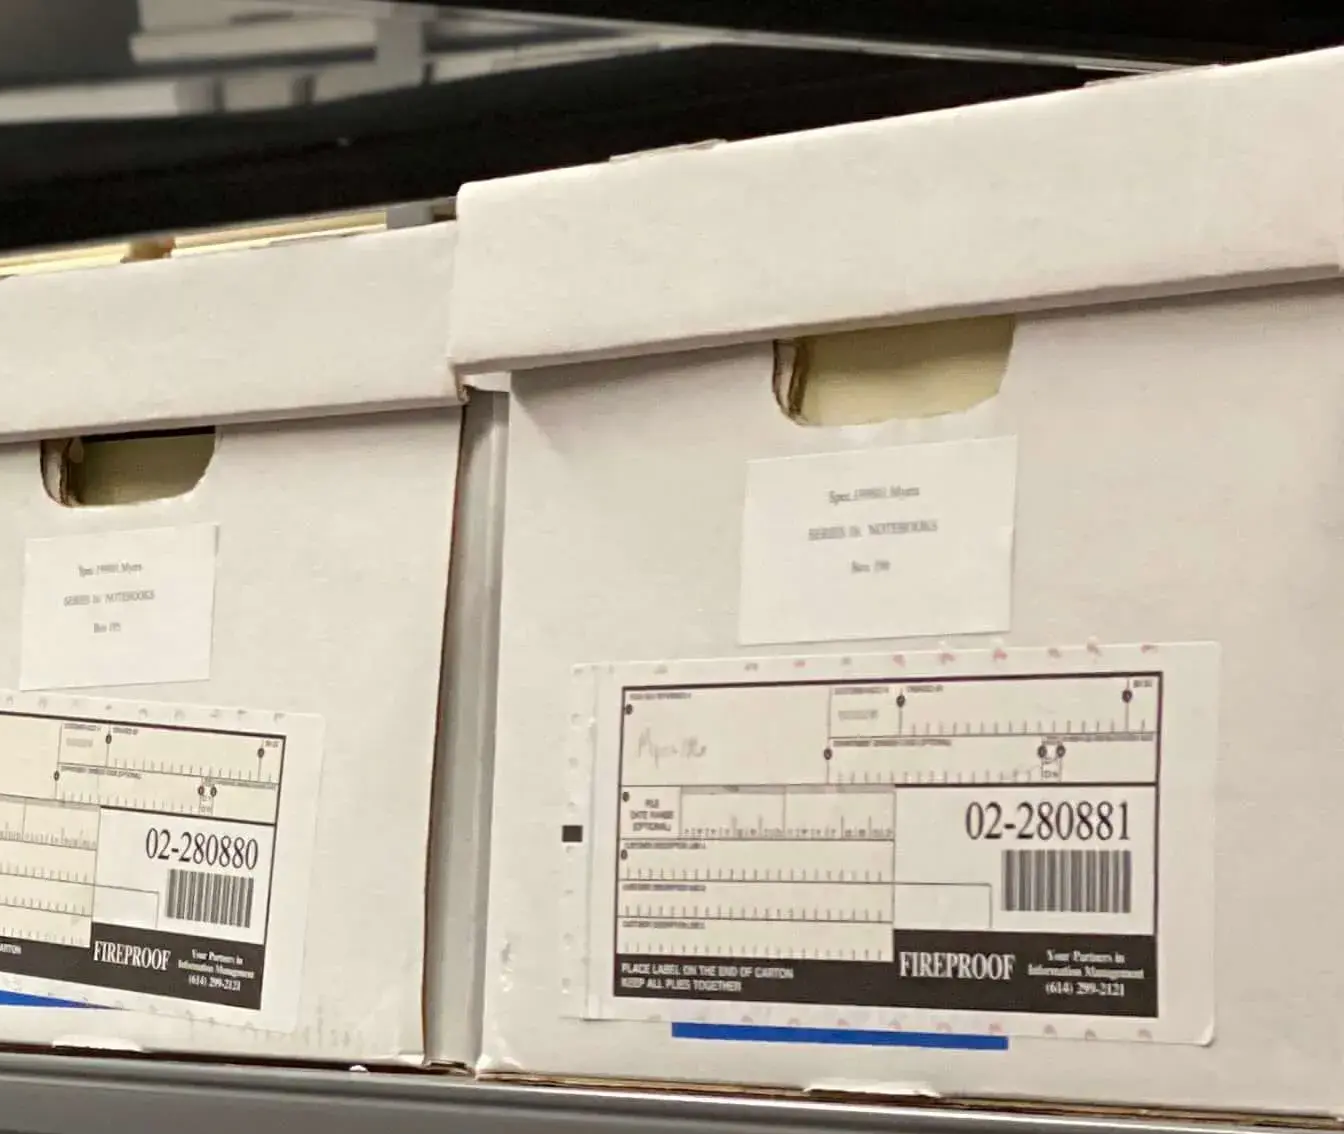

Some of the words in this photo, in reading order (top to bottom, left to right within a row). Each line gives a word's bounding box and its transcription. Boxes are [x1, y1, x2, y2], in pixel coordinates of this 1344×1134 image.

[965, 800, 1131, 841] 02-280881
[145, 827, 259, 871] 02-280880
[93, 940, 171, 971] FIREPROOF
[192, 949, 208, 960] Your
[236, 955, 243, 965] in
[1047, 950, 1070, 961] Your
[1073, 951, 1112, 963] Partners
[1115, 952, 1125, 963] in
[178, 959, 213, 973] Information
[215, 965, 255, 979] Management
[621, 963, 651, 974] PLACE
[652, 964, 680, 975] LABEL
[683, 964, 698, 976] ON
[699, 965, 716, 976] THE
[719, 966, 738, 977] END
[740, 966, 752, 978] OF
[755, 967, 794, 979] CARTON
[899, 951, 1016, 980] FIREPROOF
[1028, 964, 1082, 977] Information
[1085, 966, 1144, 980] Management
[621, 977, 645, 988] KEEP
[647, 978, 662, 989] ALL
[665, 979, 690, 990] PLIES
[694, 980, 742, 992] TOGETHER
[1045, 982, 1074, 995] (614)
